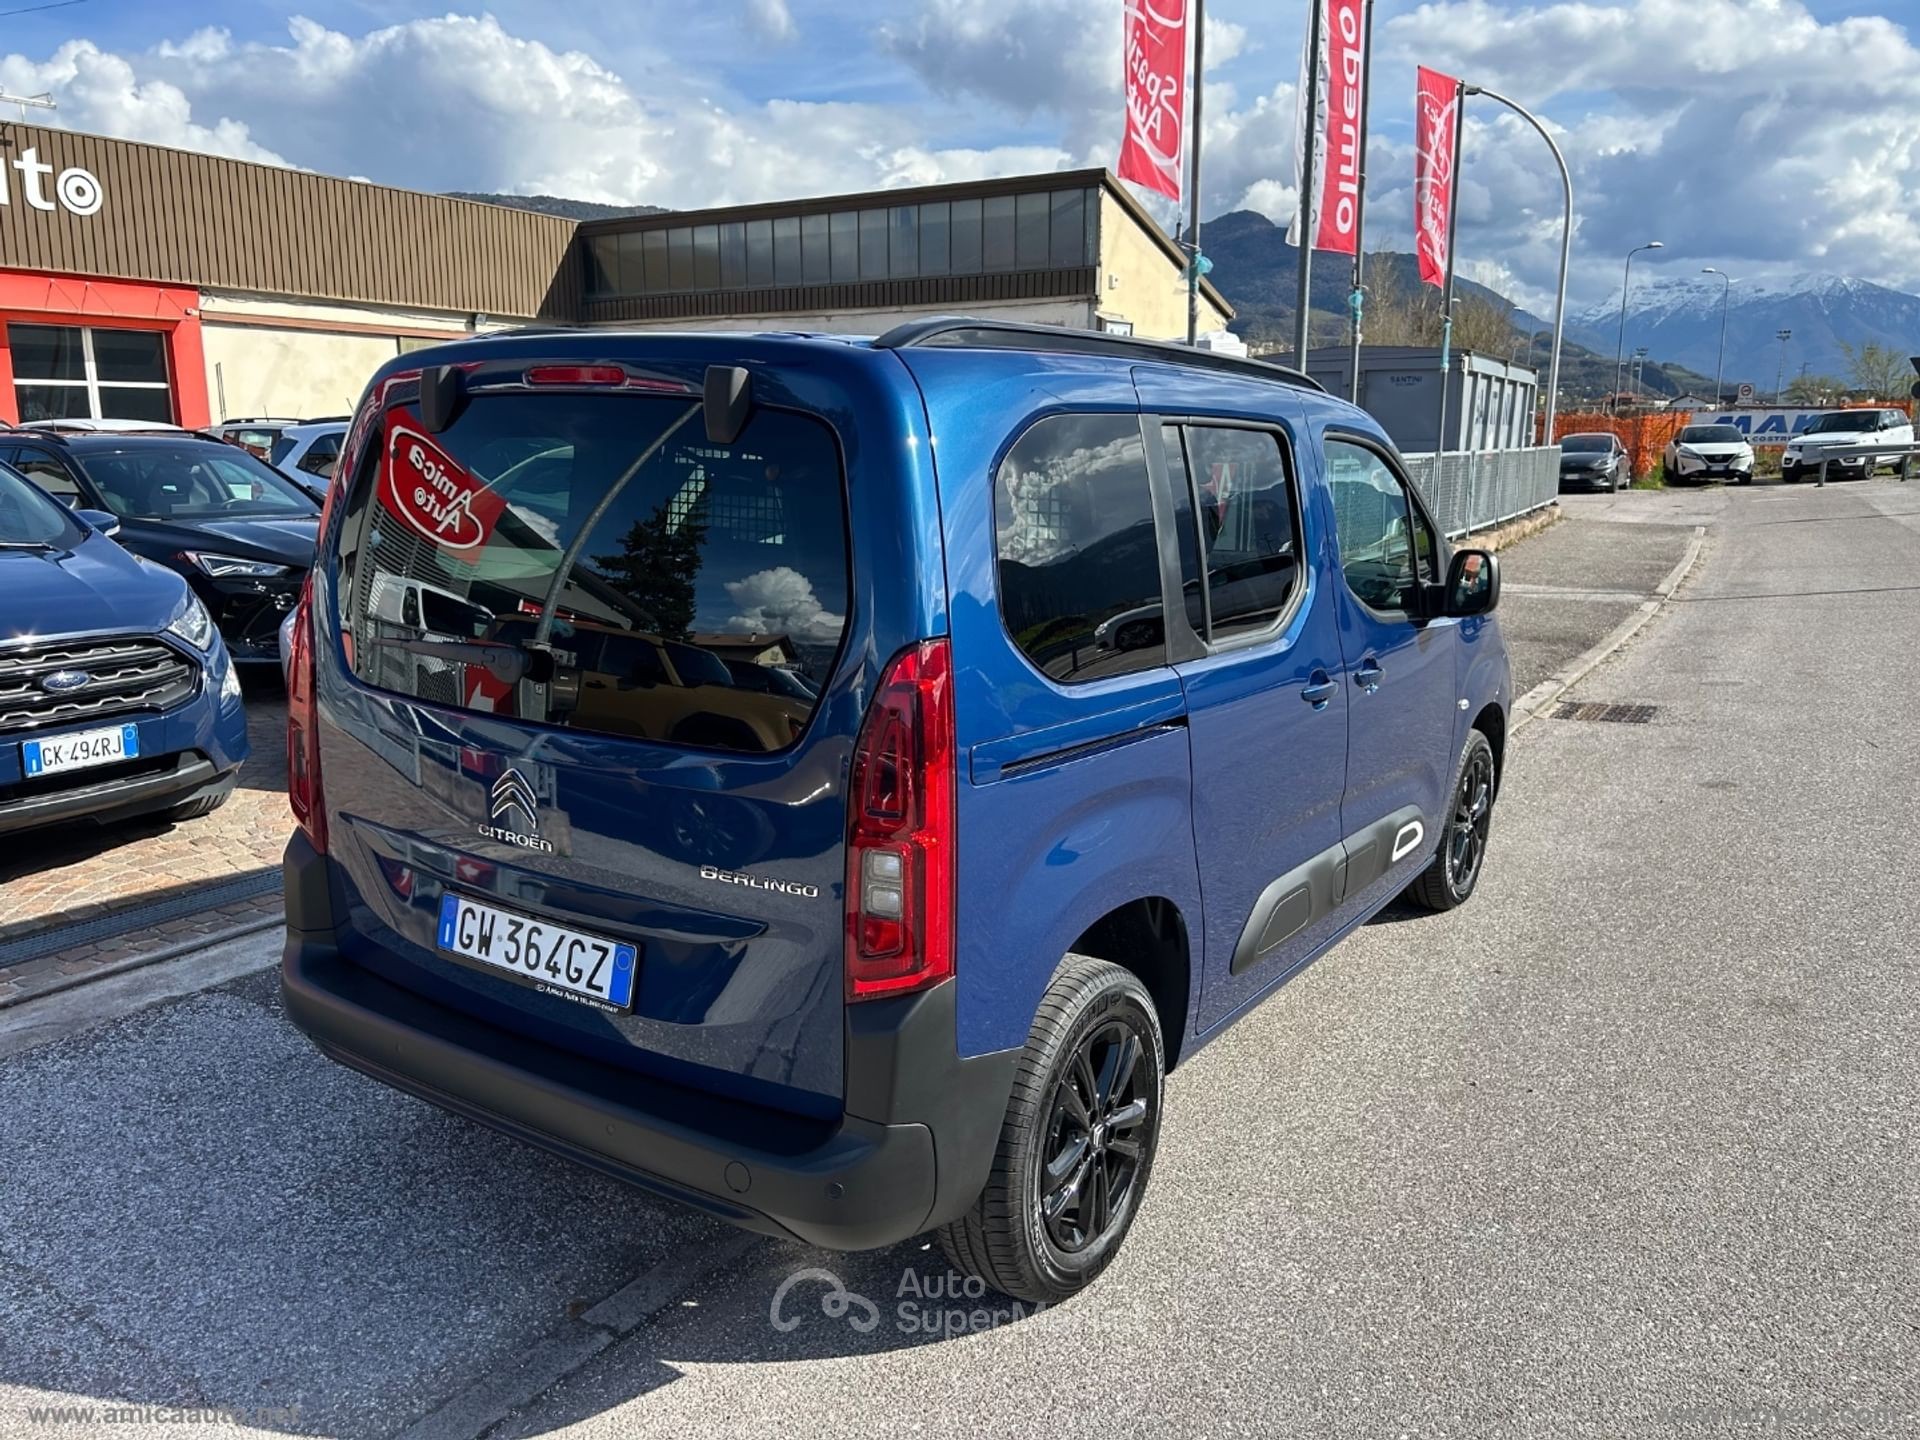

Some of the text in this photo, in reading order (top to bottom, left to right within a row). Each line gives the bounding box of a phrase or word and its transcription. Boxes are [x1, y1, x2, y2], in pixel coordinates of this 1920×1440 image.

[0, 147, 104, 217] to
[42, 735, 121, 767] GK 494RJ
[478, 824, 552, 852] CITROËN
[700, 864, 818, 898] BERLINGO
[458, 907, 610, 993] GW 364GZ
